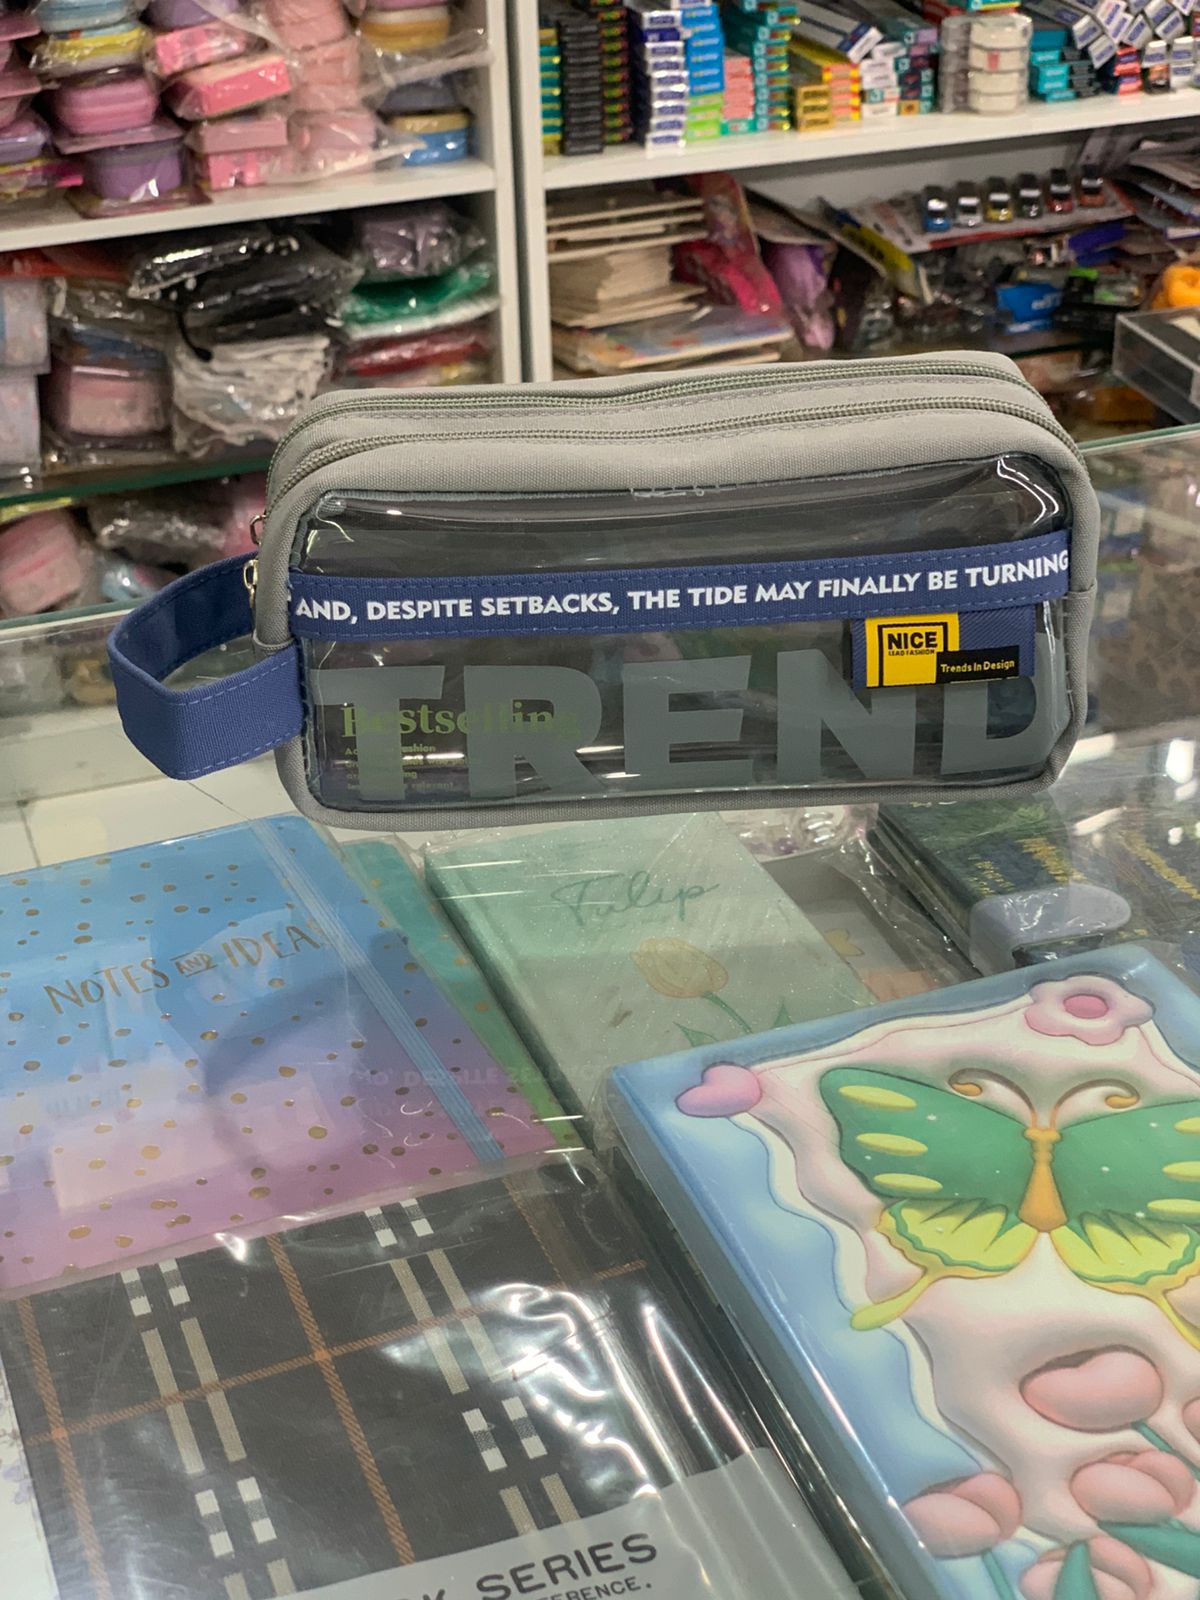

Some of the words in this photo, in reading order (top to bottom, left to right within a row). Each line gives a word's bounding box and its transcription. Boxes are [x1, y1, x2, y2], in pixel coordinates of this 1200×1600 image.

[296, 598, 358, 625] AND,
[367, 598, 474, 621] DESPITE
[481, 592, 620, 617] SETBACKS,
[627, 588, 681, 610] THE
[687, 584, 748, 607] TIDE
[754, 580, 812, 603] MAY
[818, 572, 922, 598] FINALLY
[928, 569, 958, 591] BE
[965, 549, 1069, 588] TURNING
[887, 631, 938, 650] NICE
[940, 663, 972, 674] Trends
[973, 661, 983, 671] In
[983, 659, 1015, 673] Design
[309, 634, 1070, 802] TREND
[551, 870, 720, 927] Tulip
[172, 951, 218, 977] AND
[475, 1533, 657, 1600] SERIES
